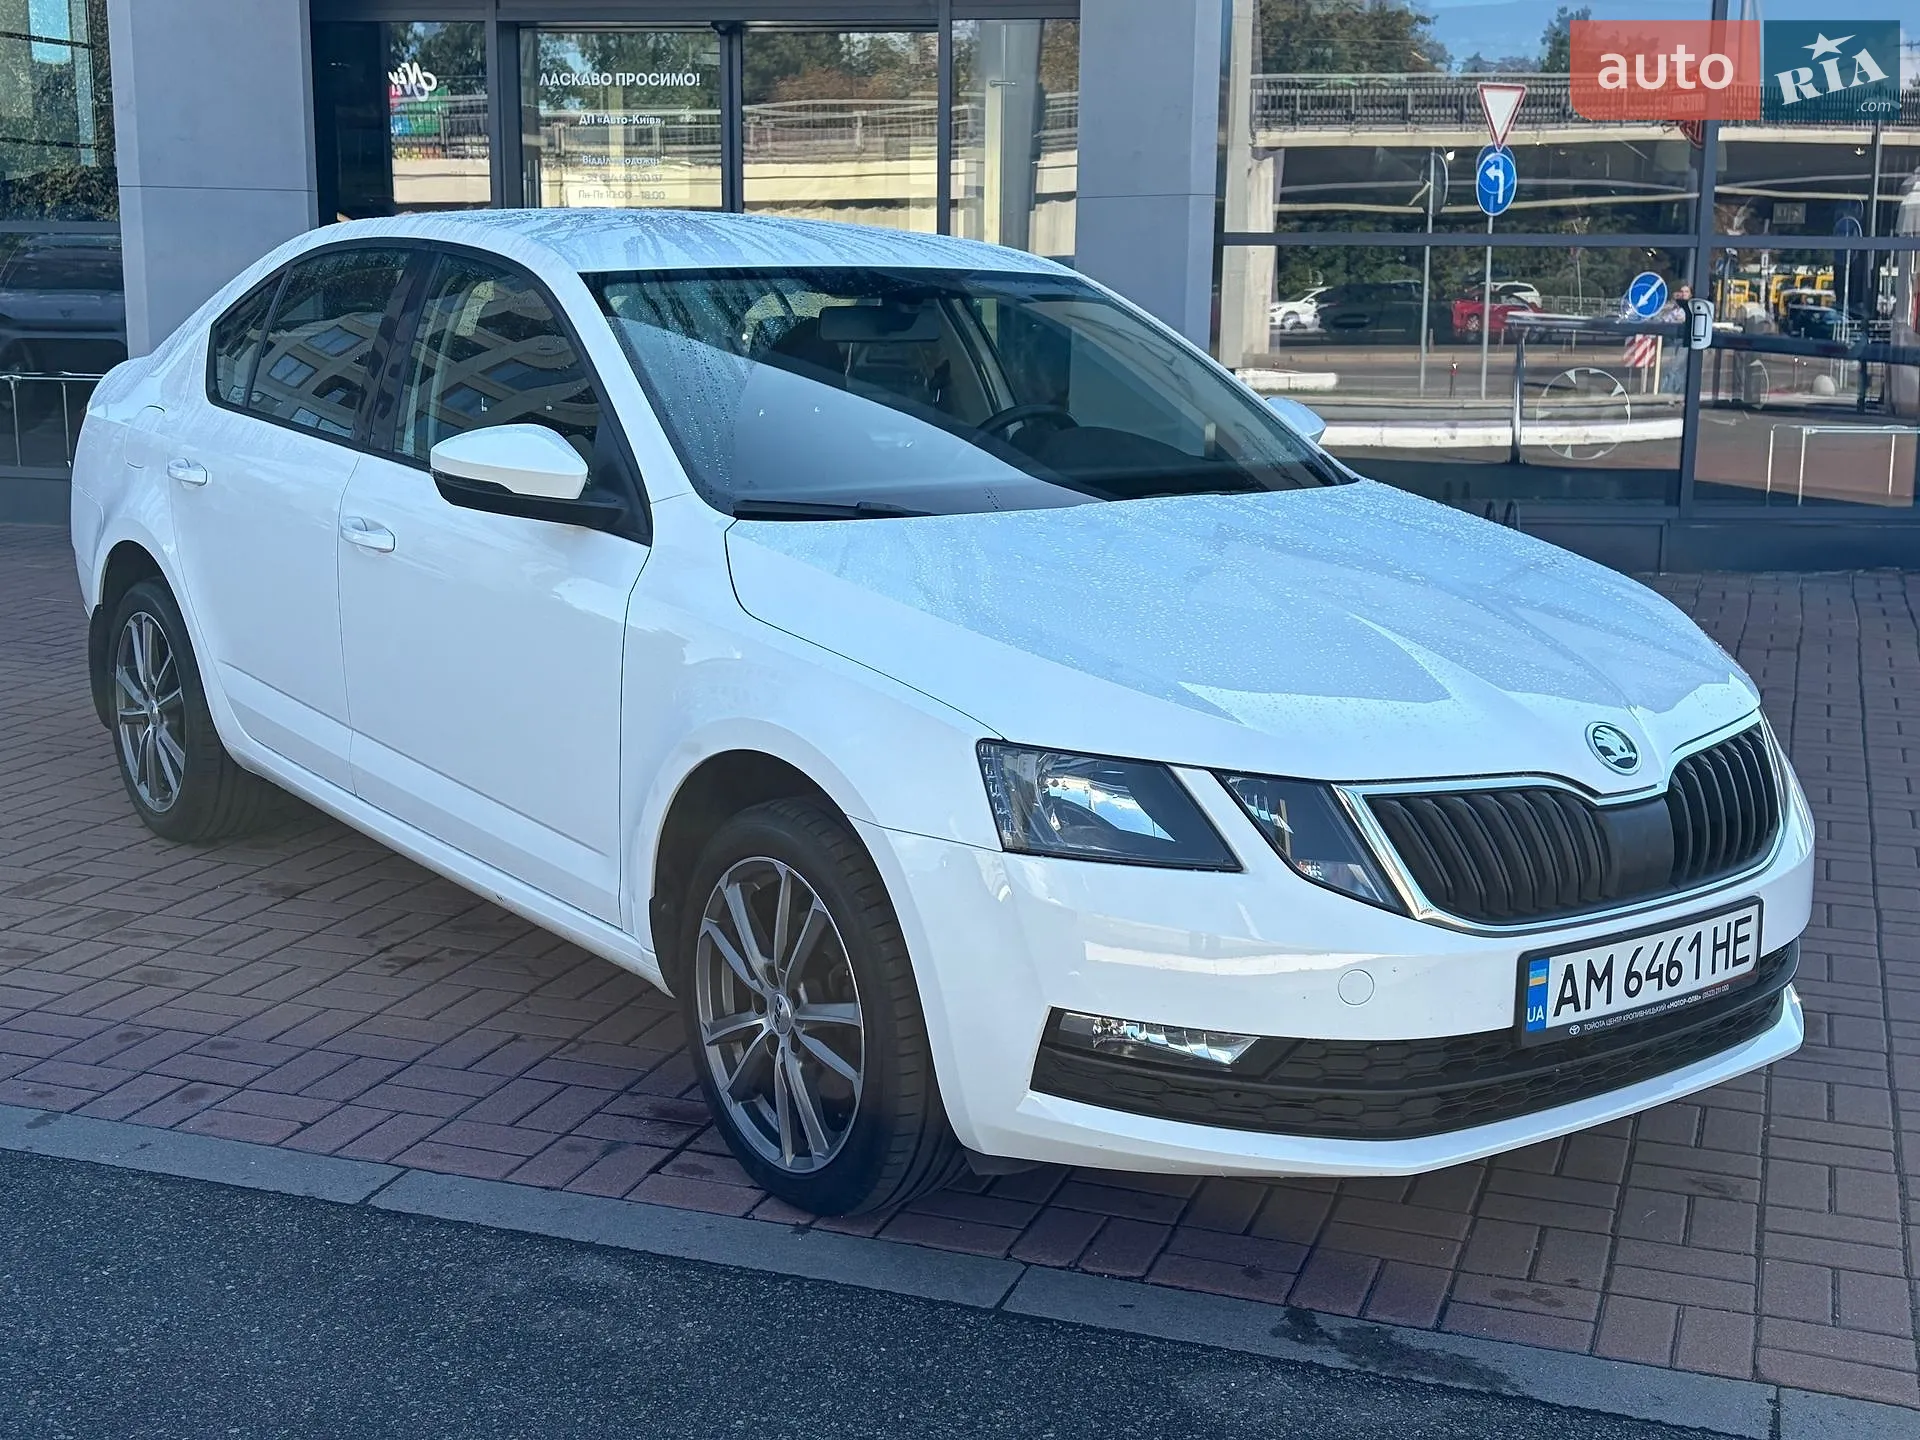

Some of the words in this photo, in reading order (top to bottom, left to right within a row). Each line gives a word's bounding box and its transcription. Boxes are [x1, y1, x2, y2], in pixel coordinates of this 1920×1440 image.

[539, 72, 613, 87] ЛАСКАВО
[615, 72, 701, 87] ПРОСИМО!
[579, 114, 595, 126] ДП
[1552, 953, 1614, 1018] AM
[1624, 930, 1703, 999] 6461
[1711, 914, 1752, 976] HE
[1527, 1006, 1545, 1023] UA
